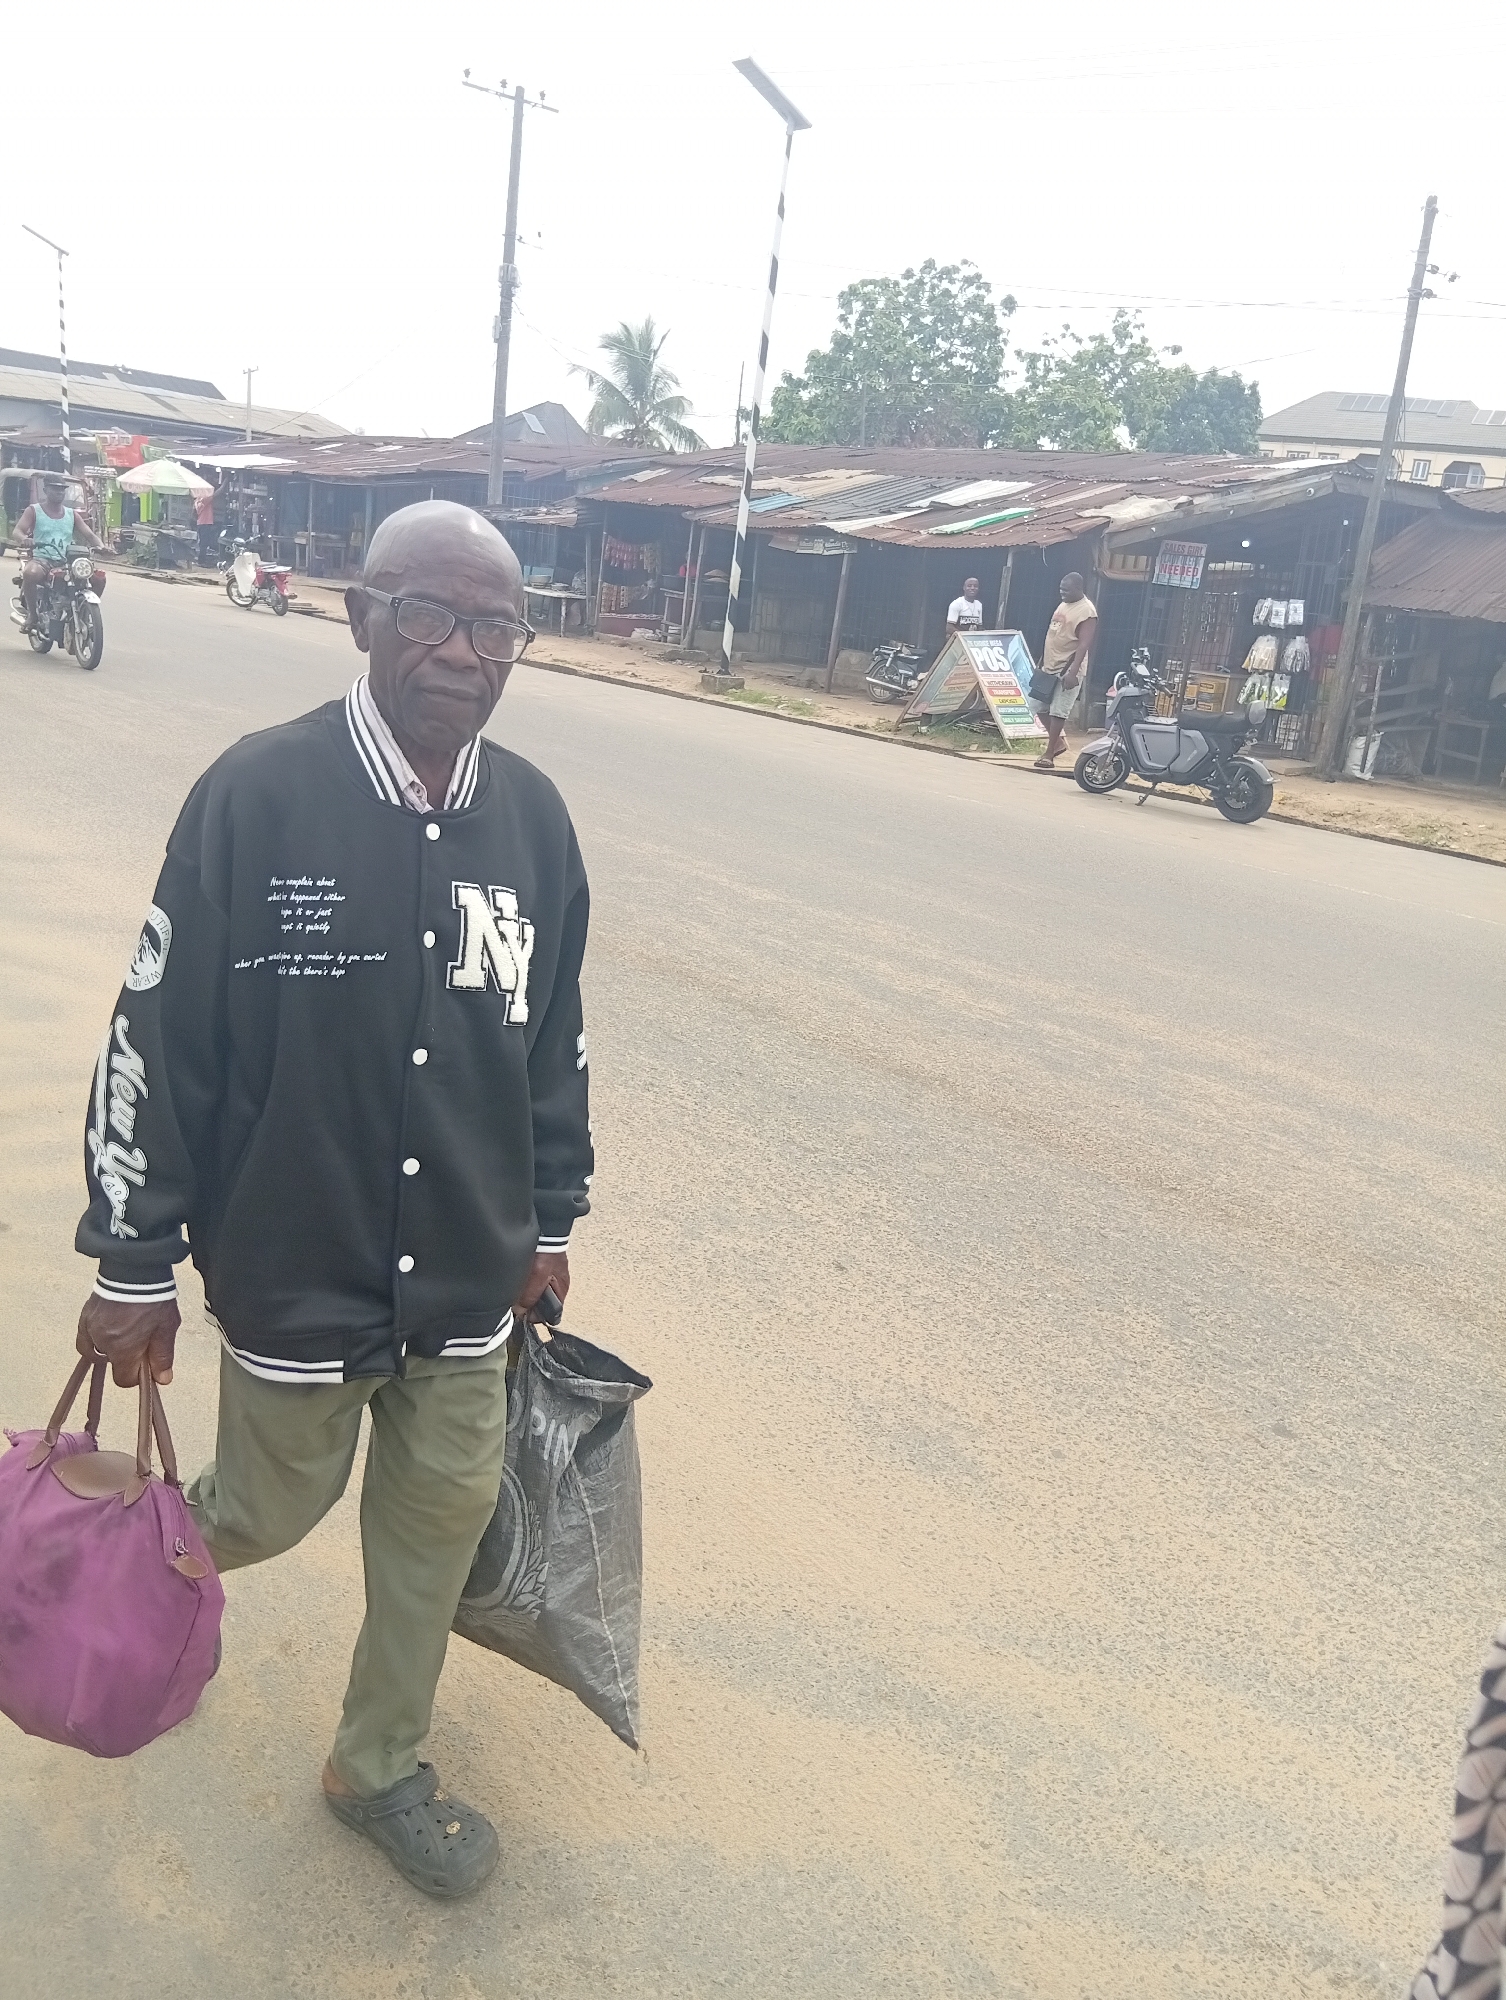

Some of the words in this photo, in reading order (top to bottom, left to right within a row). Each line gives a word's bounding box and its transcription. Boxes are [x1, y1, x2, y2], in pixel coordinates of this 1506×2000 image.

[1164, 542, 1186, 554] SALES
[1187, 545, 1205, 557] GIRL
[1159, 563, 1199, 577] NEEDED
[969, 646, 1010, 671] POS
[305, 921, 331, 934] quietly
[133, 970, 162, 988] WEAR
[110, 1014, 149, 1143] New
